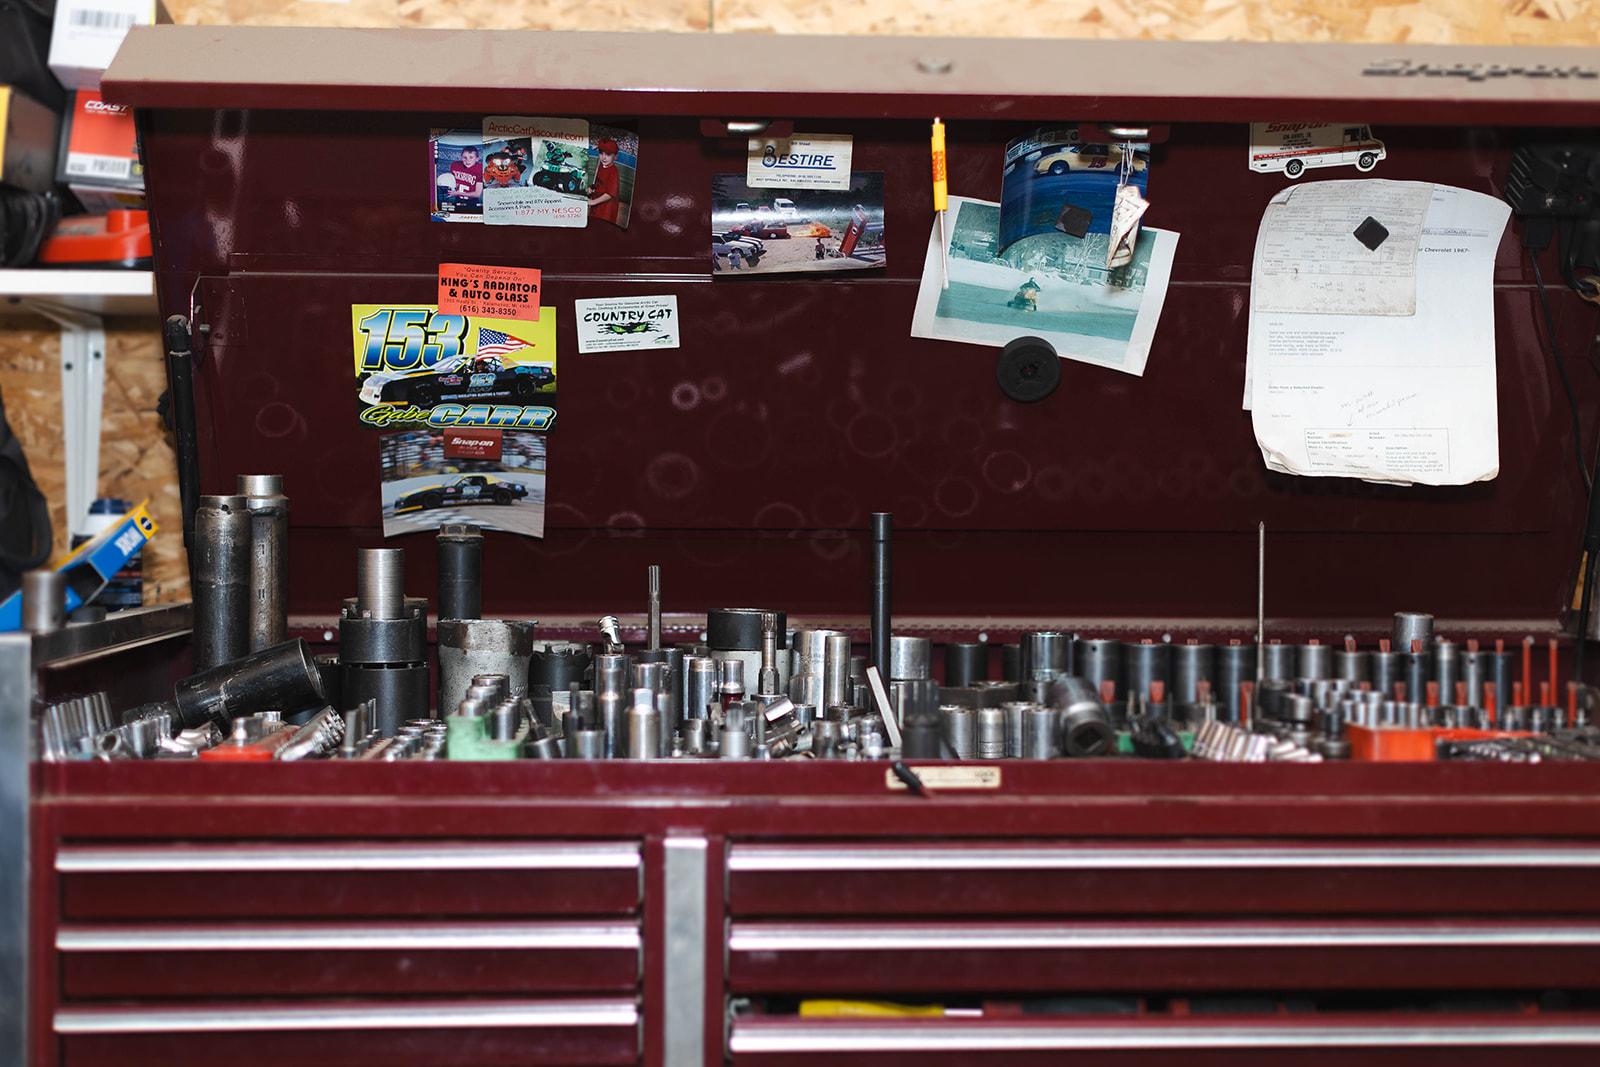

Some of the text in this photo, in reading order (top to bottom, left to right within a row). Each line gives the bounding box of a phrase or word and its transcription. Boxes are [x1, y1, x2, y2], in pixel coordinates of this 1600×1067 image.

[488, 121, 584, 142] ArcticCatDiscount.com
[552, 206, 582, 214] NESCO
[441, 277, 538, 294] KING'S RADIATOR
[449, 288, 529, 303] & AUTO GLASS
[460, 304, 516, 316] (616) 343-8350
[584, 308, 673, 322] COUNTRY CAT
[359, 308, 469, 371] 153
[360, 404, 557, 430] Gabe CARR
[451, 437, 495, 448] Snap-on
